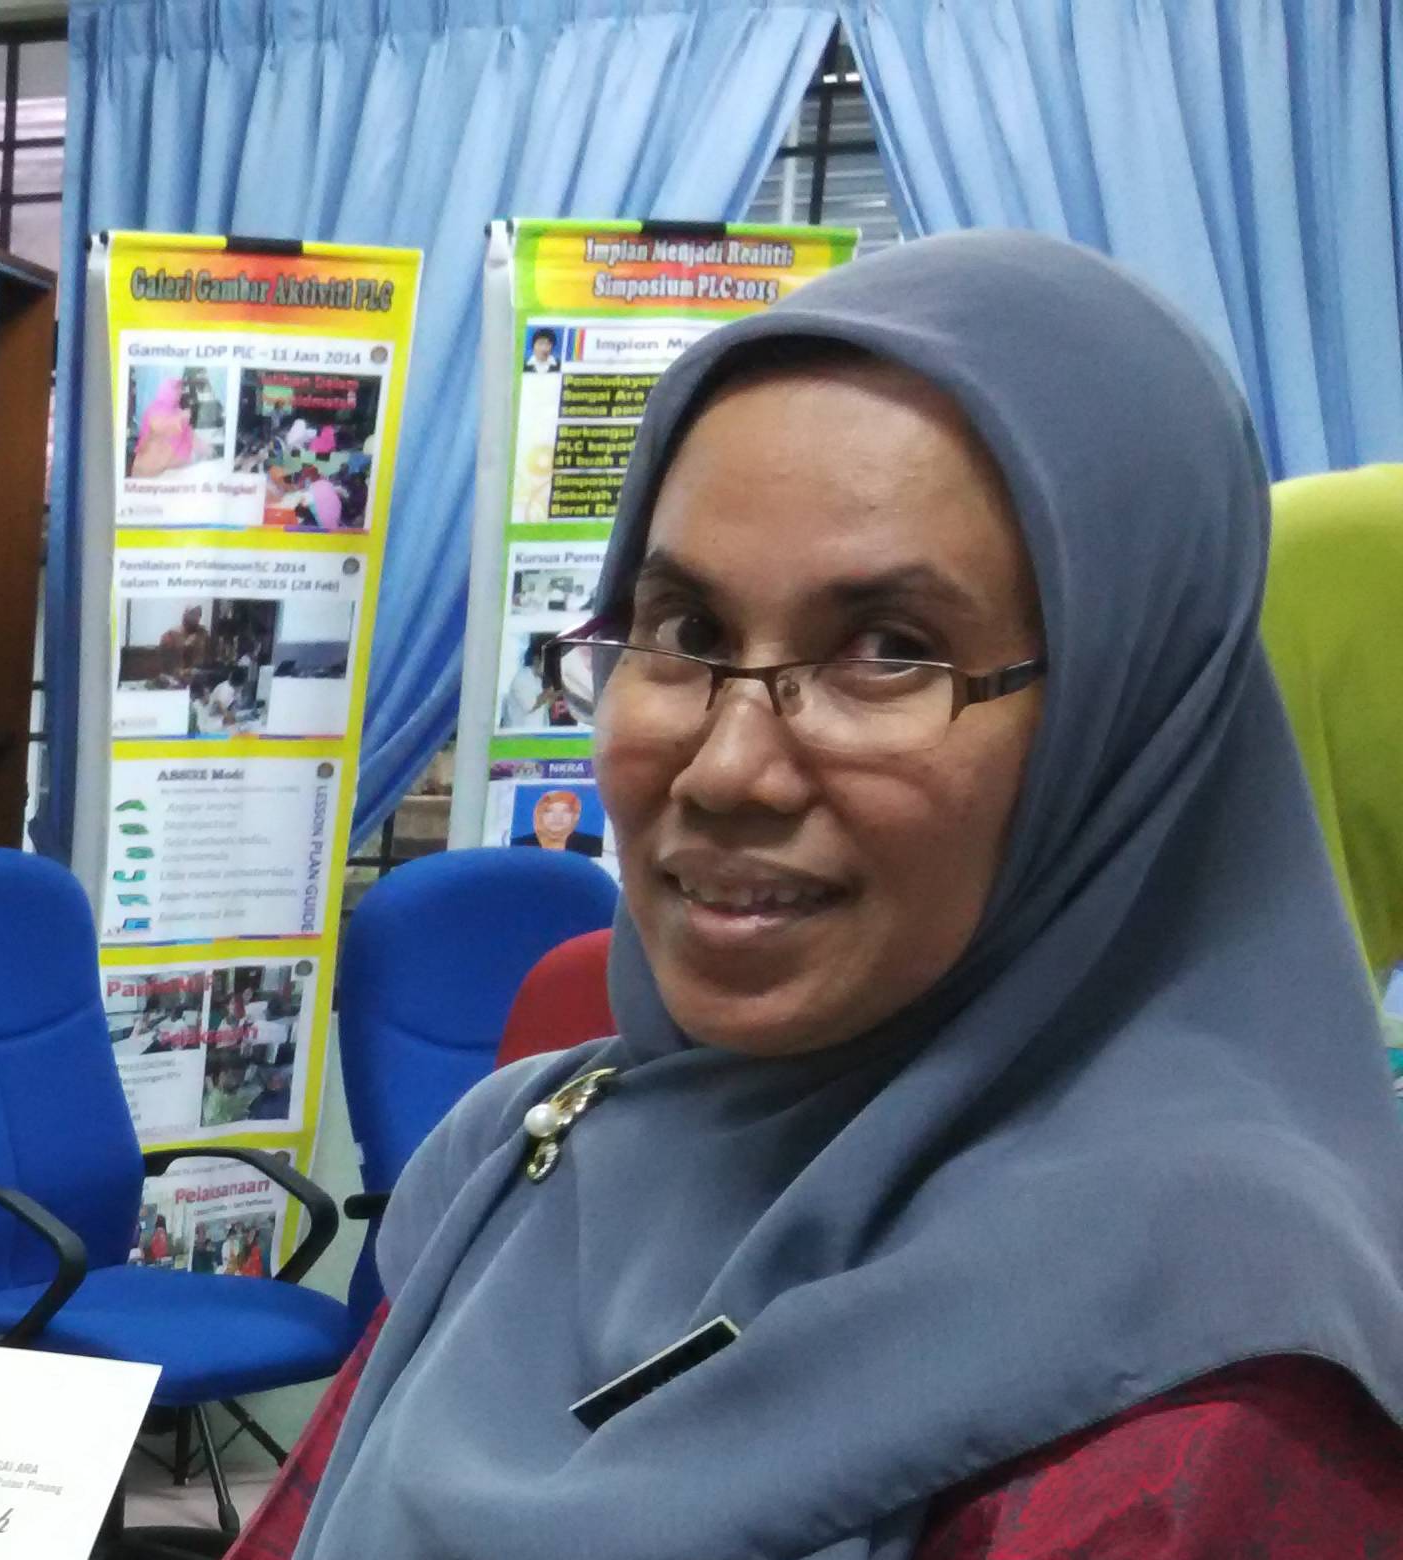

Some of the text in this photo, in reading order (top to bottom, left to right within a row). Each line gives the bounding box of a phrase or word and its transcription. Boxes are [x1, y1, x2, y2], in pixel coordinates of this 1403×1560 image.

[585, 237, 648, 266] Impian
[651, 239, 724, 266] Menjadi
[131, 266, 394, 312] Galeri Gambar Aktiviti PLC
[593, 272, 780, 303] Simposium PLC 2015
[128, 344, 190, 359] Gambar
[293, 347, 320, 362] Jan
[324, 349, 361, 365] 2014
[596, 337, 659, 353] Impian
[301, 785, 328, 933] LESSON PLAN GUIDE
[13, 1463, 39, 1475] ARA
[26, 1478, 63, 1496] Pinang
